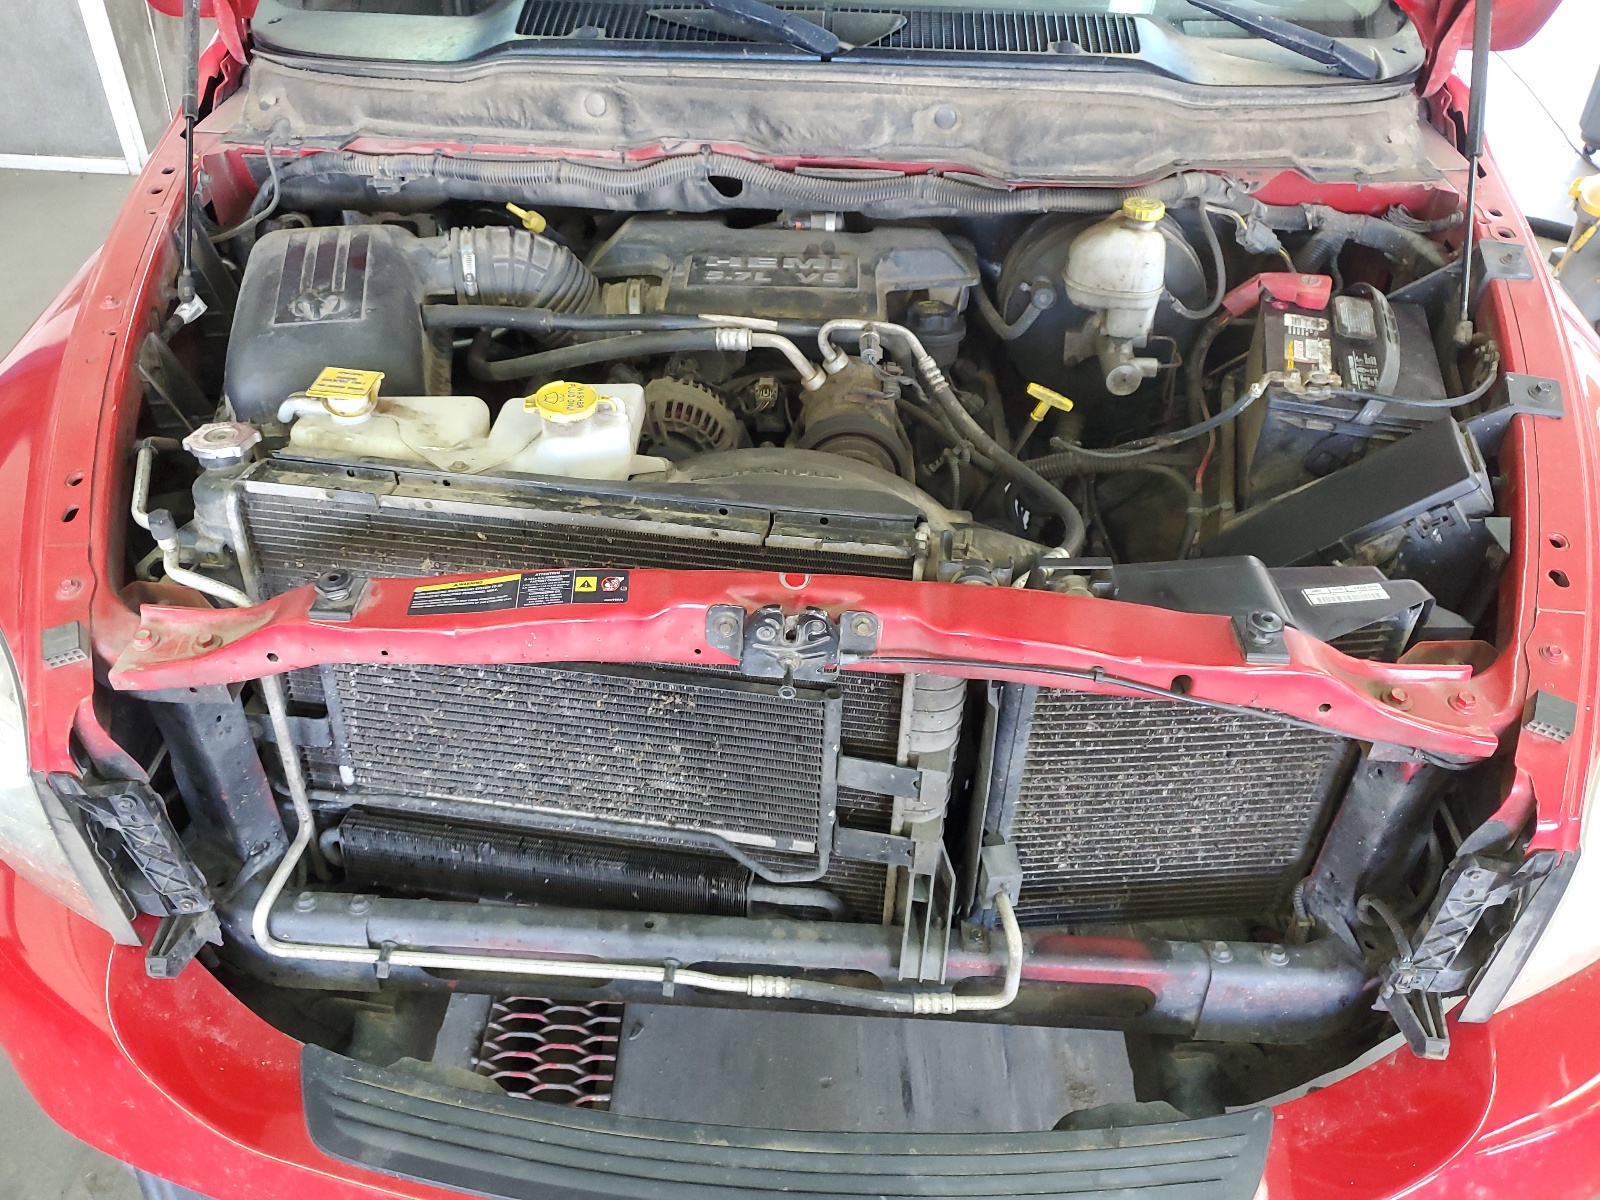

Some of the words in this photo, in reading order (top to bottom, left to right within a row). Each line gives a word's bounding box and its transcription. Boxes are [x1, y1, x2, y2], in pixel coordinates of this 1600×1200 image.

[705, 256, 844, 270] HEMI
[705, 270, 772, 282] 5.7L
[795, 272, 842, 284] V8
[577, 386, 585, 408] WASHER
